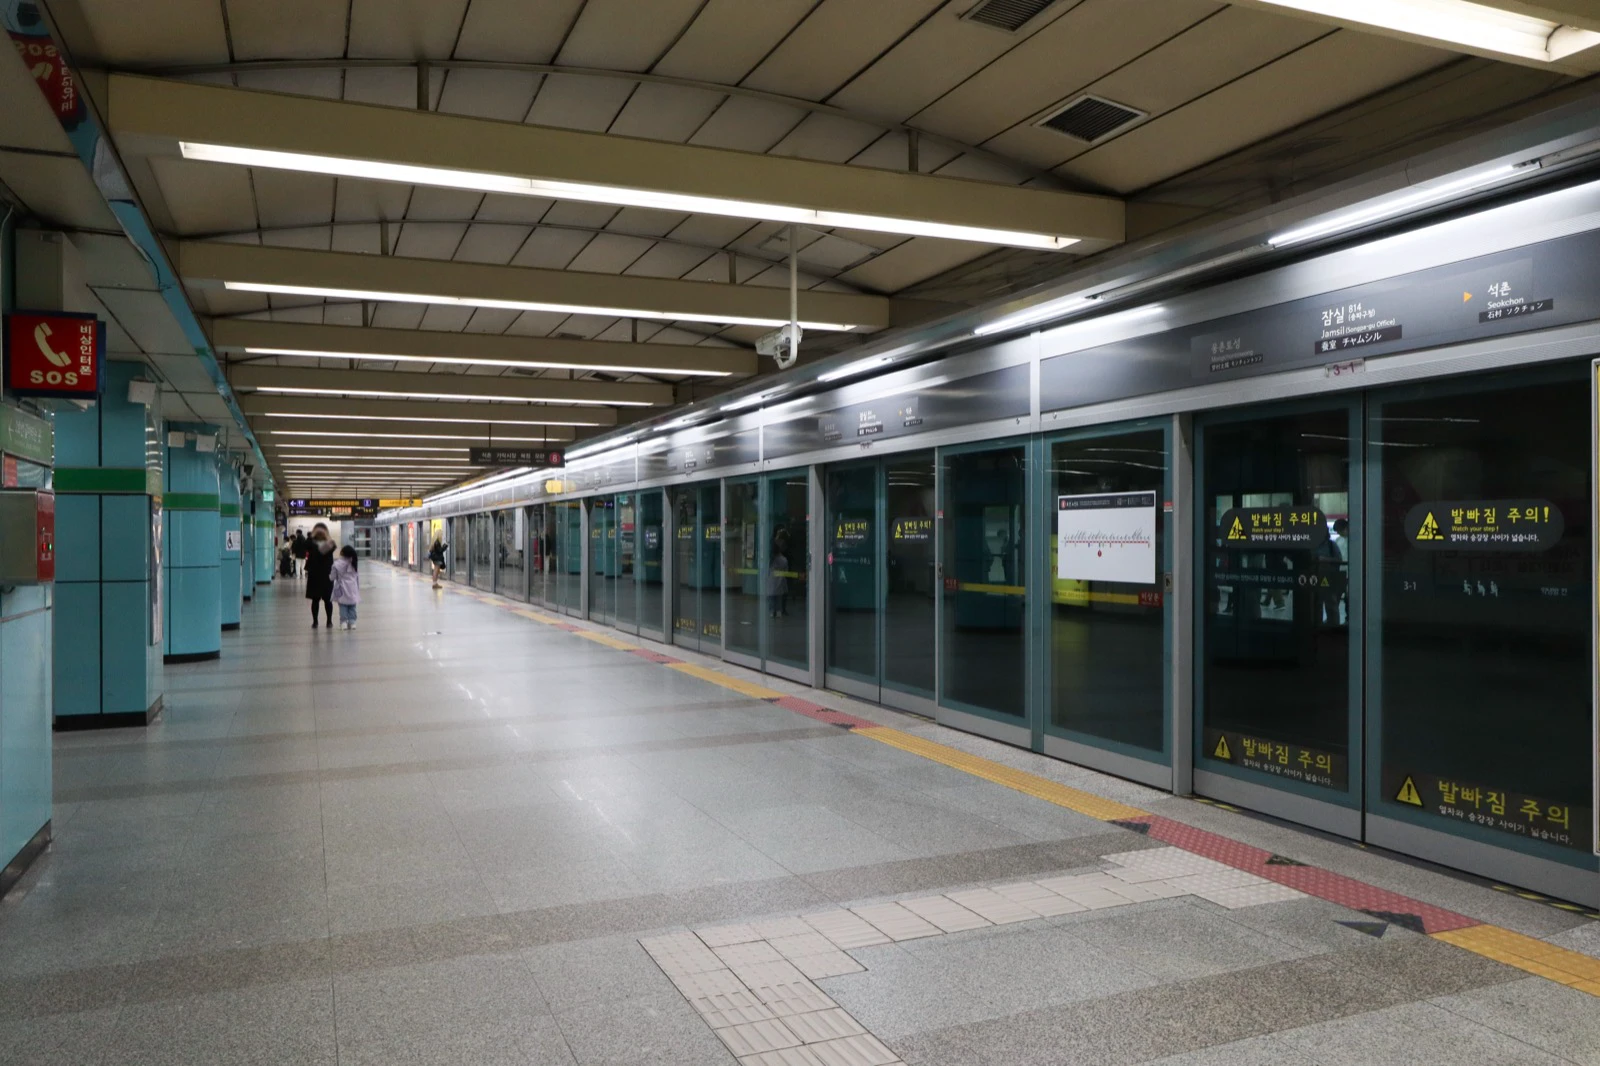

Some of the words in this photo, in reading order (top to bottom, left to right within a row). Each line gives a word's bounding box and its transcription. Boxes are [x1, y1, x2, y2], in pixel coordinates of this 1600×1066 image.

[1488, 281, 1511, 298] 석촌
[1488, 297, 1524, 309] Seokchon
[1321, 306, 1345, 327] 잠실
[1348, 302, 1362, 314] 814
[1321, 326, 1345, 339] Jamsil
[1376, 318, 1396, 328] Office)
[1342, 332, 1382, 348] チャムシル
[80, 325, 93, 376] 비상인터폰
[30, 369, 78, 385] SOS
[1333, 361, 1355, 376] 3-1
[1251, 513, 1282, 526] 발빠짐
[1289, 512, 1318, 526] 주의!
[1451, 507, 1496, 525] 발빠짐
[1507, 506, 1550, 524] 주의!
[1470, 533, 1489, 542] 승강장
[1491, 533, 1509, 542] 사이가
[1403, 581, 1417, 591] 3-1
[1243, 738, 1288, 765] 발빠짐
[1298, 750, 1331, 774] 주의
[1438, 780, 1505, 815] 발빠짐
[1520, 799, 1569, 829] 주의
[1439, 804, 1464, 819] 열차와
[1468, 812, 1495, 827] 승강장
